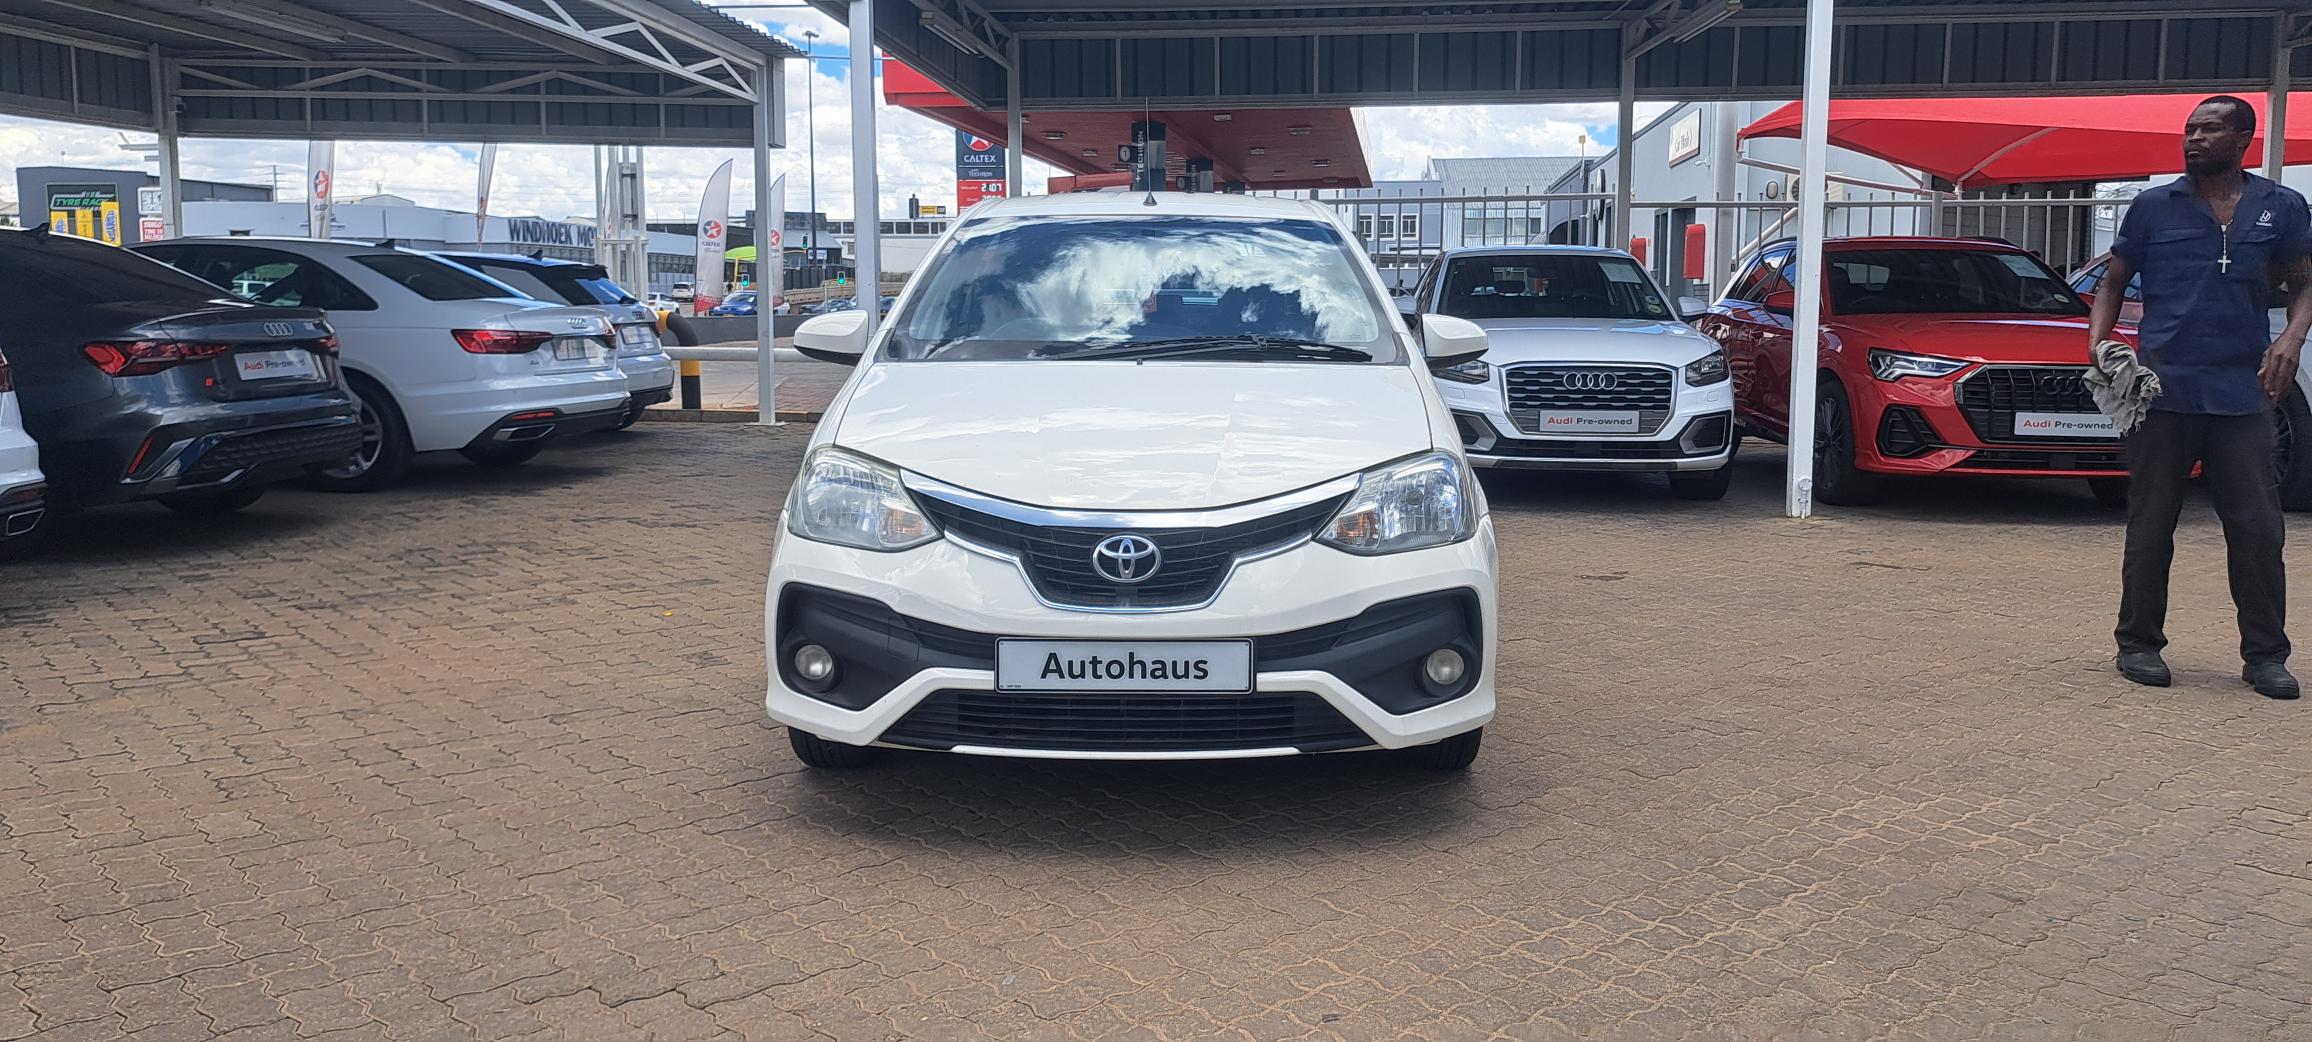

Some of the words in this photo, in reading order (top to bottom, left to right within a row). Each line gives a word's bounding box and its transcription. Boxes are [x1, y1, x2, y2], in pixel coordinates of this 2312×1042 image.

[963, 154, 997, 163] CALTEX
[508, 219, 573, 245] WINDHOEK
[244, 361, 264, 371] Audi
[1547, 416, 1573, 425] Audi
[1576, 417, 1633, 426] Pre-owned
[2023, 419, 2051, 428] Audi
[2054, 420, 2114, 430] Pre-owned
[1040, 652, 1209, 680] Autohaus
